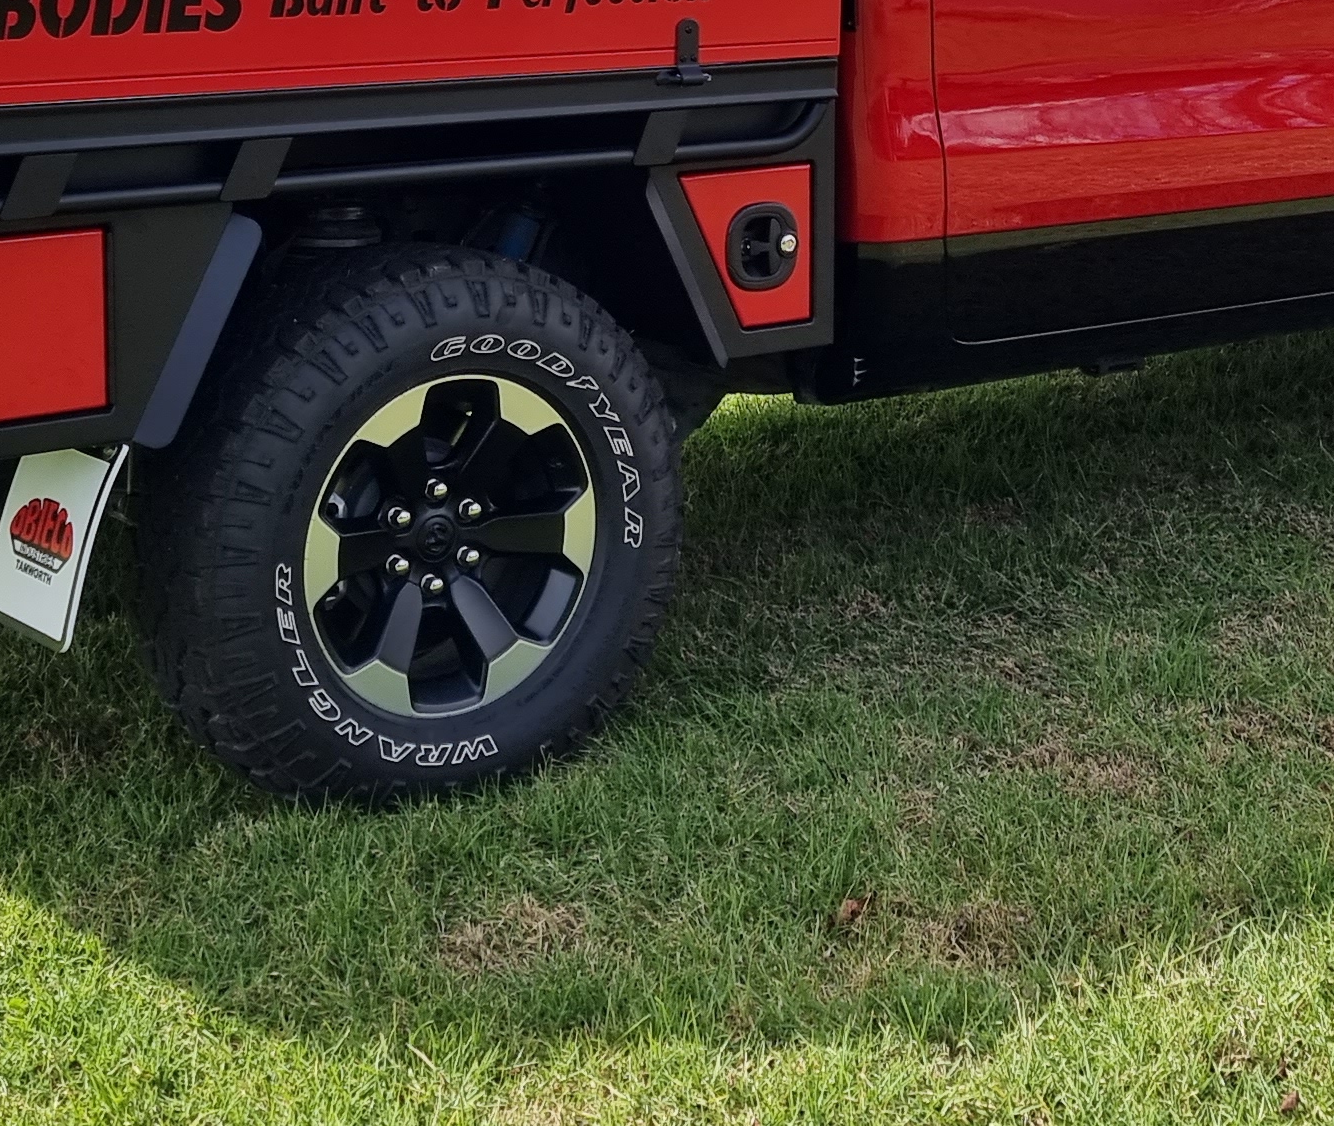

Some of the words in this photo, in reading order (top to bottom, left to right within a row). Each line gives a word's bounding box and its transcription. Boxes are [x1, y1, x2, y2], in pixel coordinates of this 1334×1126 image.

[430, 333, 644, 549] GOODYEAR
[10, 498, 73, 562] OBIECO
[14, 558, 53, 586] TAMWORTH
[275, 562, 499, 766] WRANGLER
